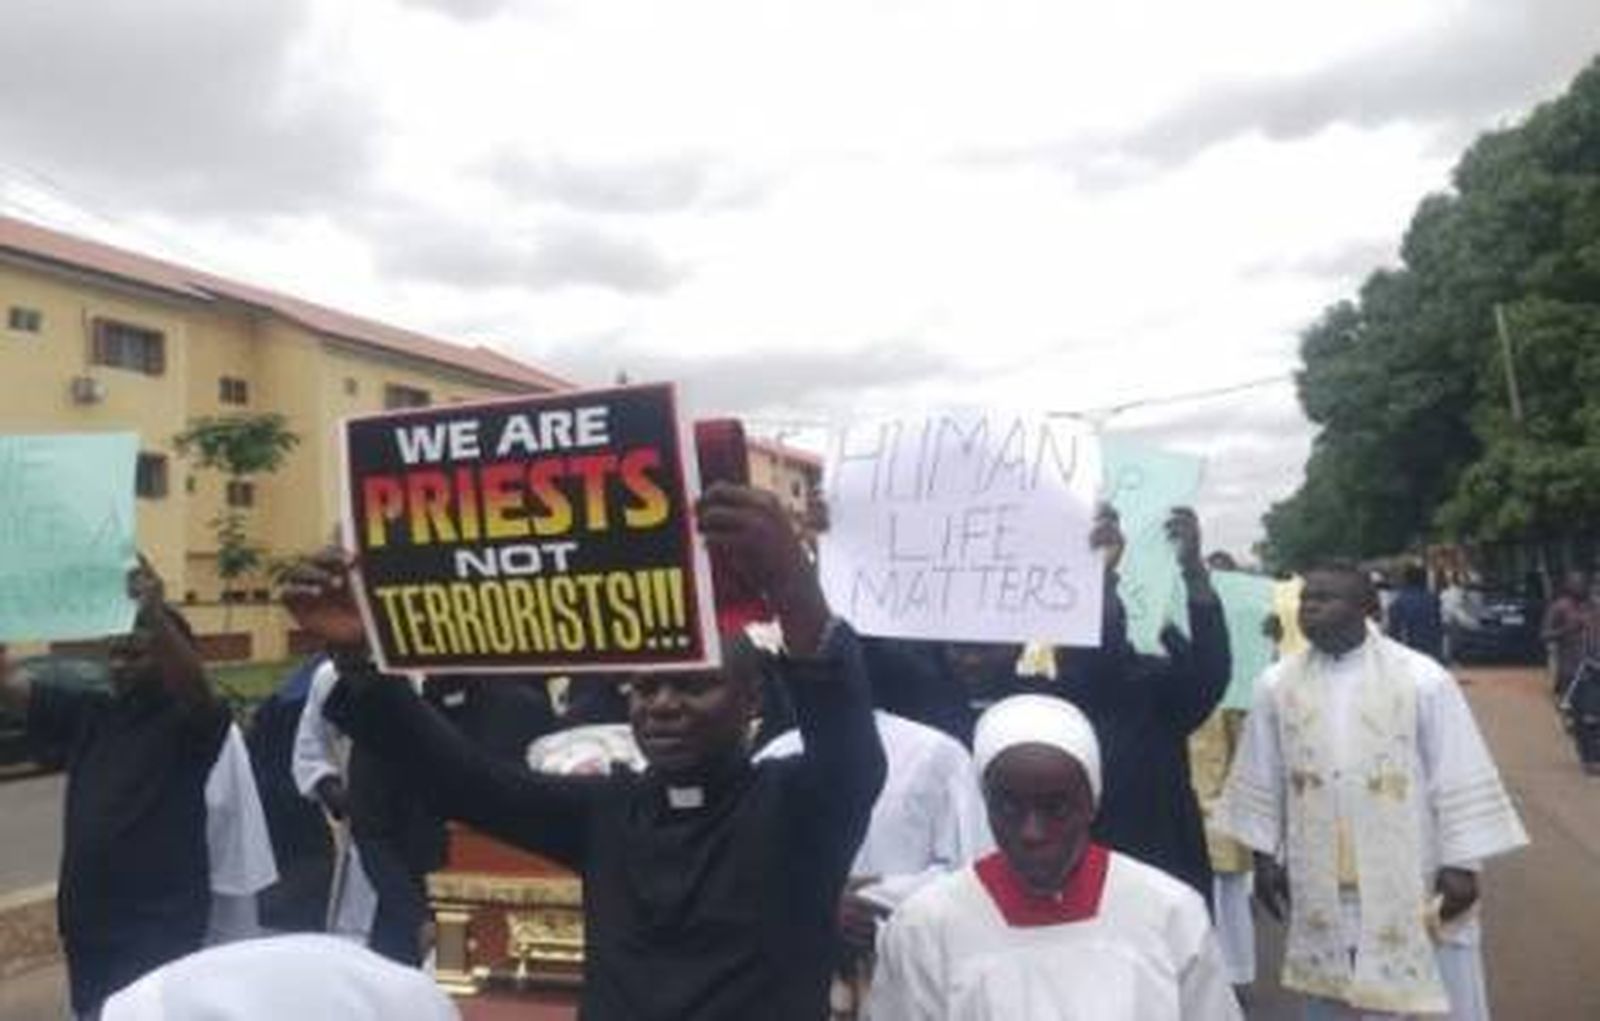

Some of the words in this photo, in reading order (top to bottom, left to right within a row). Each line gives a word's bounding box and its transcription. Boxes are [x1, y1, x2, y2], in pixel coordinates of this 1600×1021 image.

[395, 420, 480, 464] WE
[496, 406, 611, 454] ARE
[832, 415, 1078, 502] HUMAN
[362, 448, 670, 548] PRIESTS
[454, 542, 579, 578] NOT
[888, 503, 1022, 563] LIFE
[376, 568, 690, 656] TERRORISTS!!!
[850, 564, 1079, 619] MATTERS
